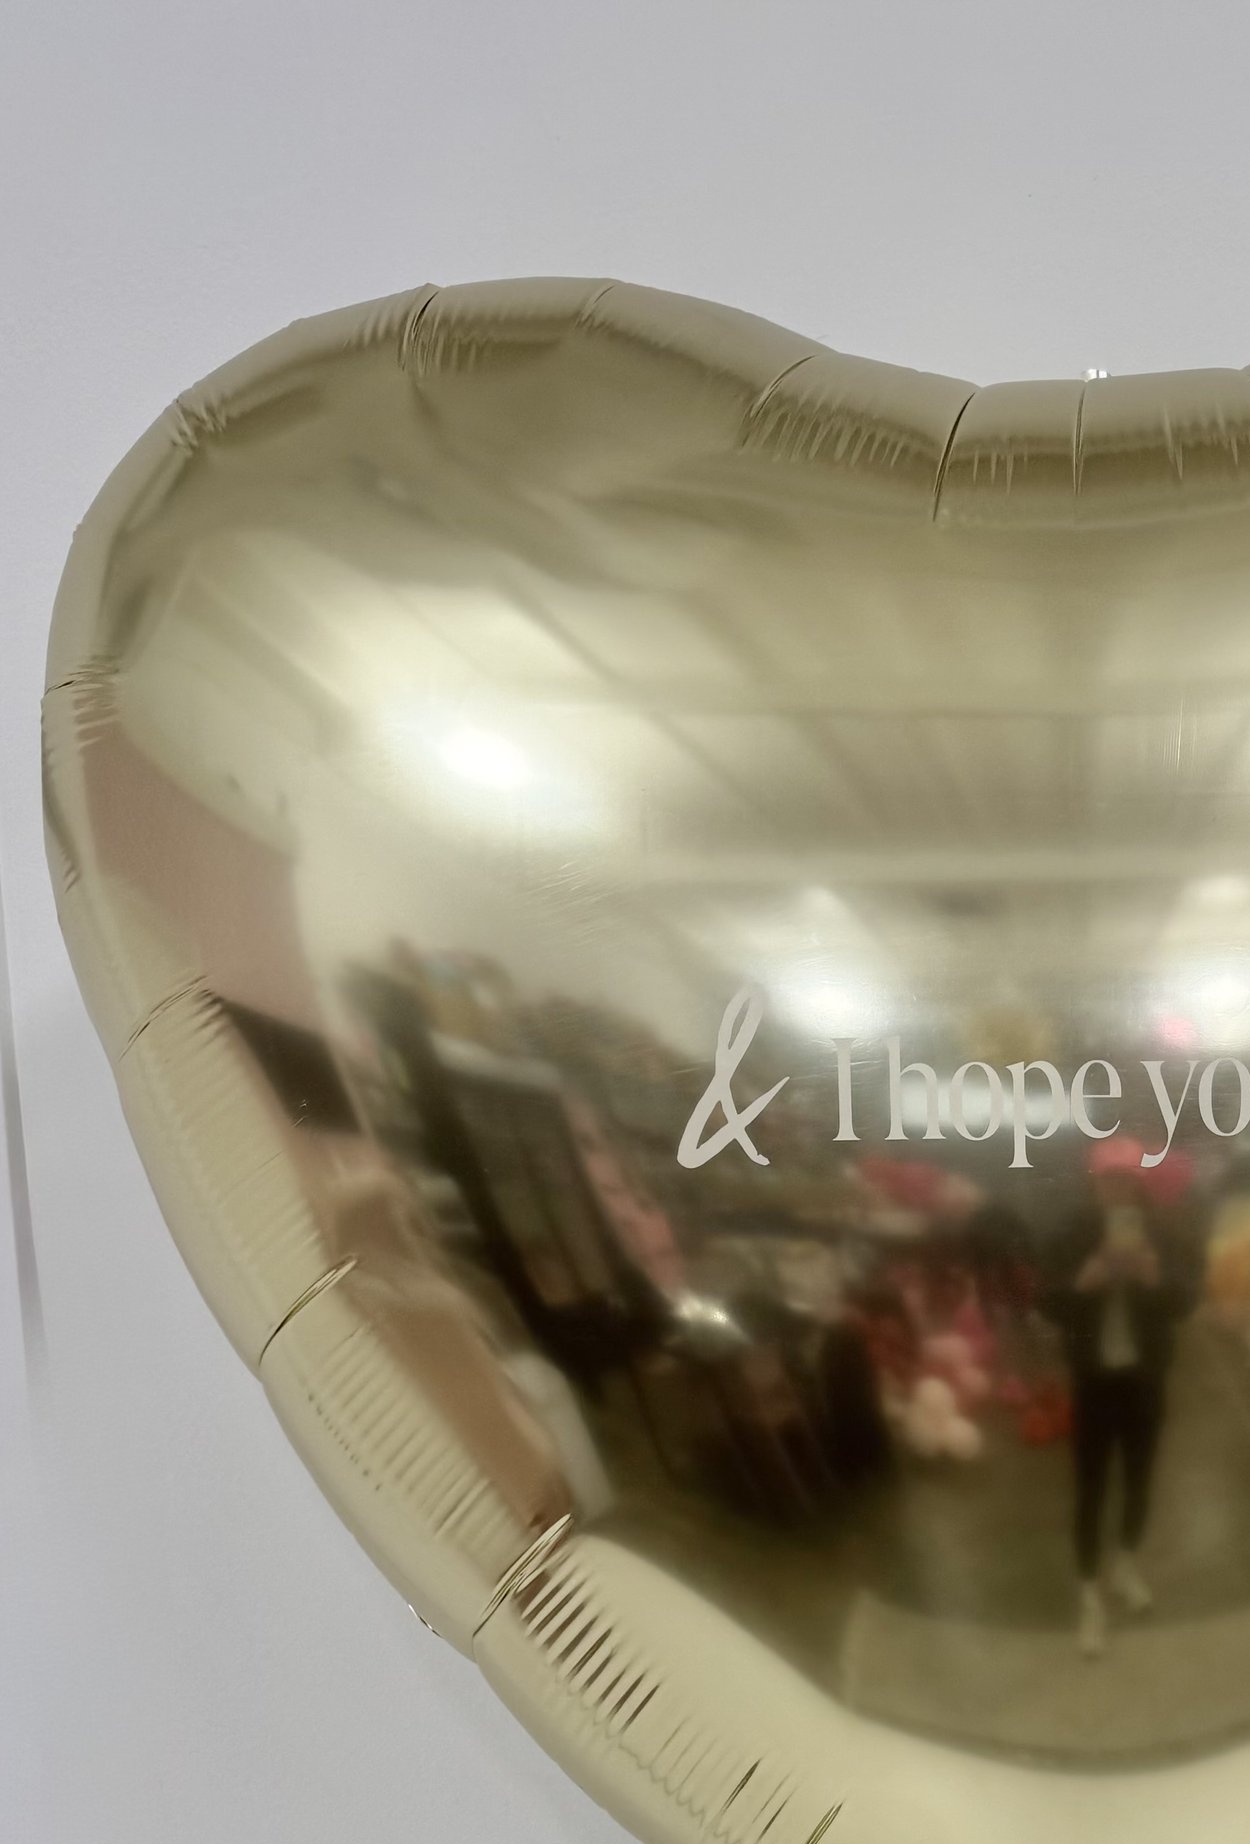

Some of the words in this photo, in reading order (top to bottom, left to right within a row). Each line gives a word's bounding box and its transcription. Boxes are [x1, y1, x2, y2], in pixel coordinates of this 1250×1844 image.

[676, 985, 790, 1169] &
[831, 1036, 861, 1142] I
[884, 1034, 1123, 1168] hope
